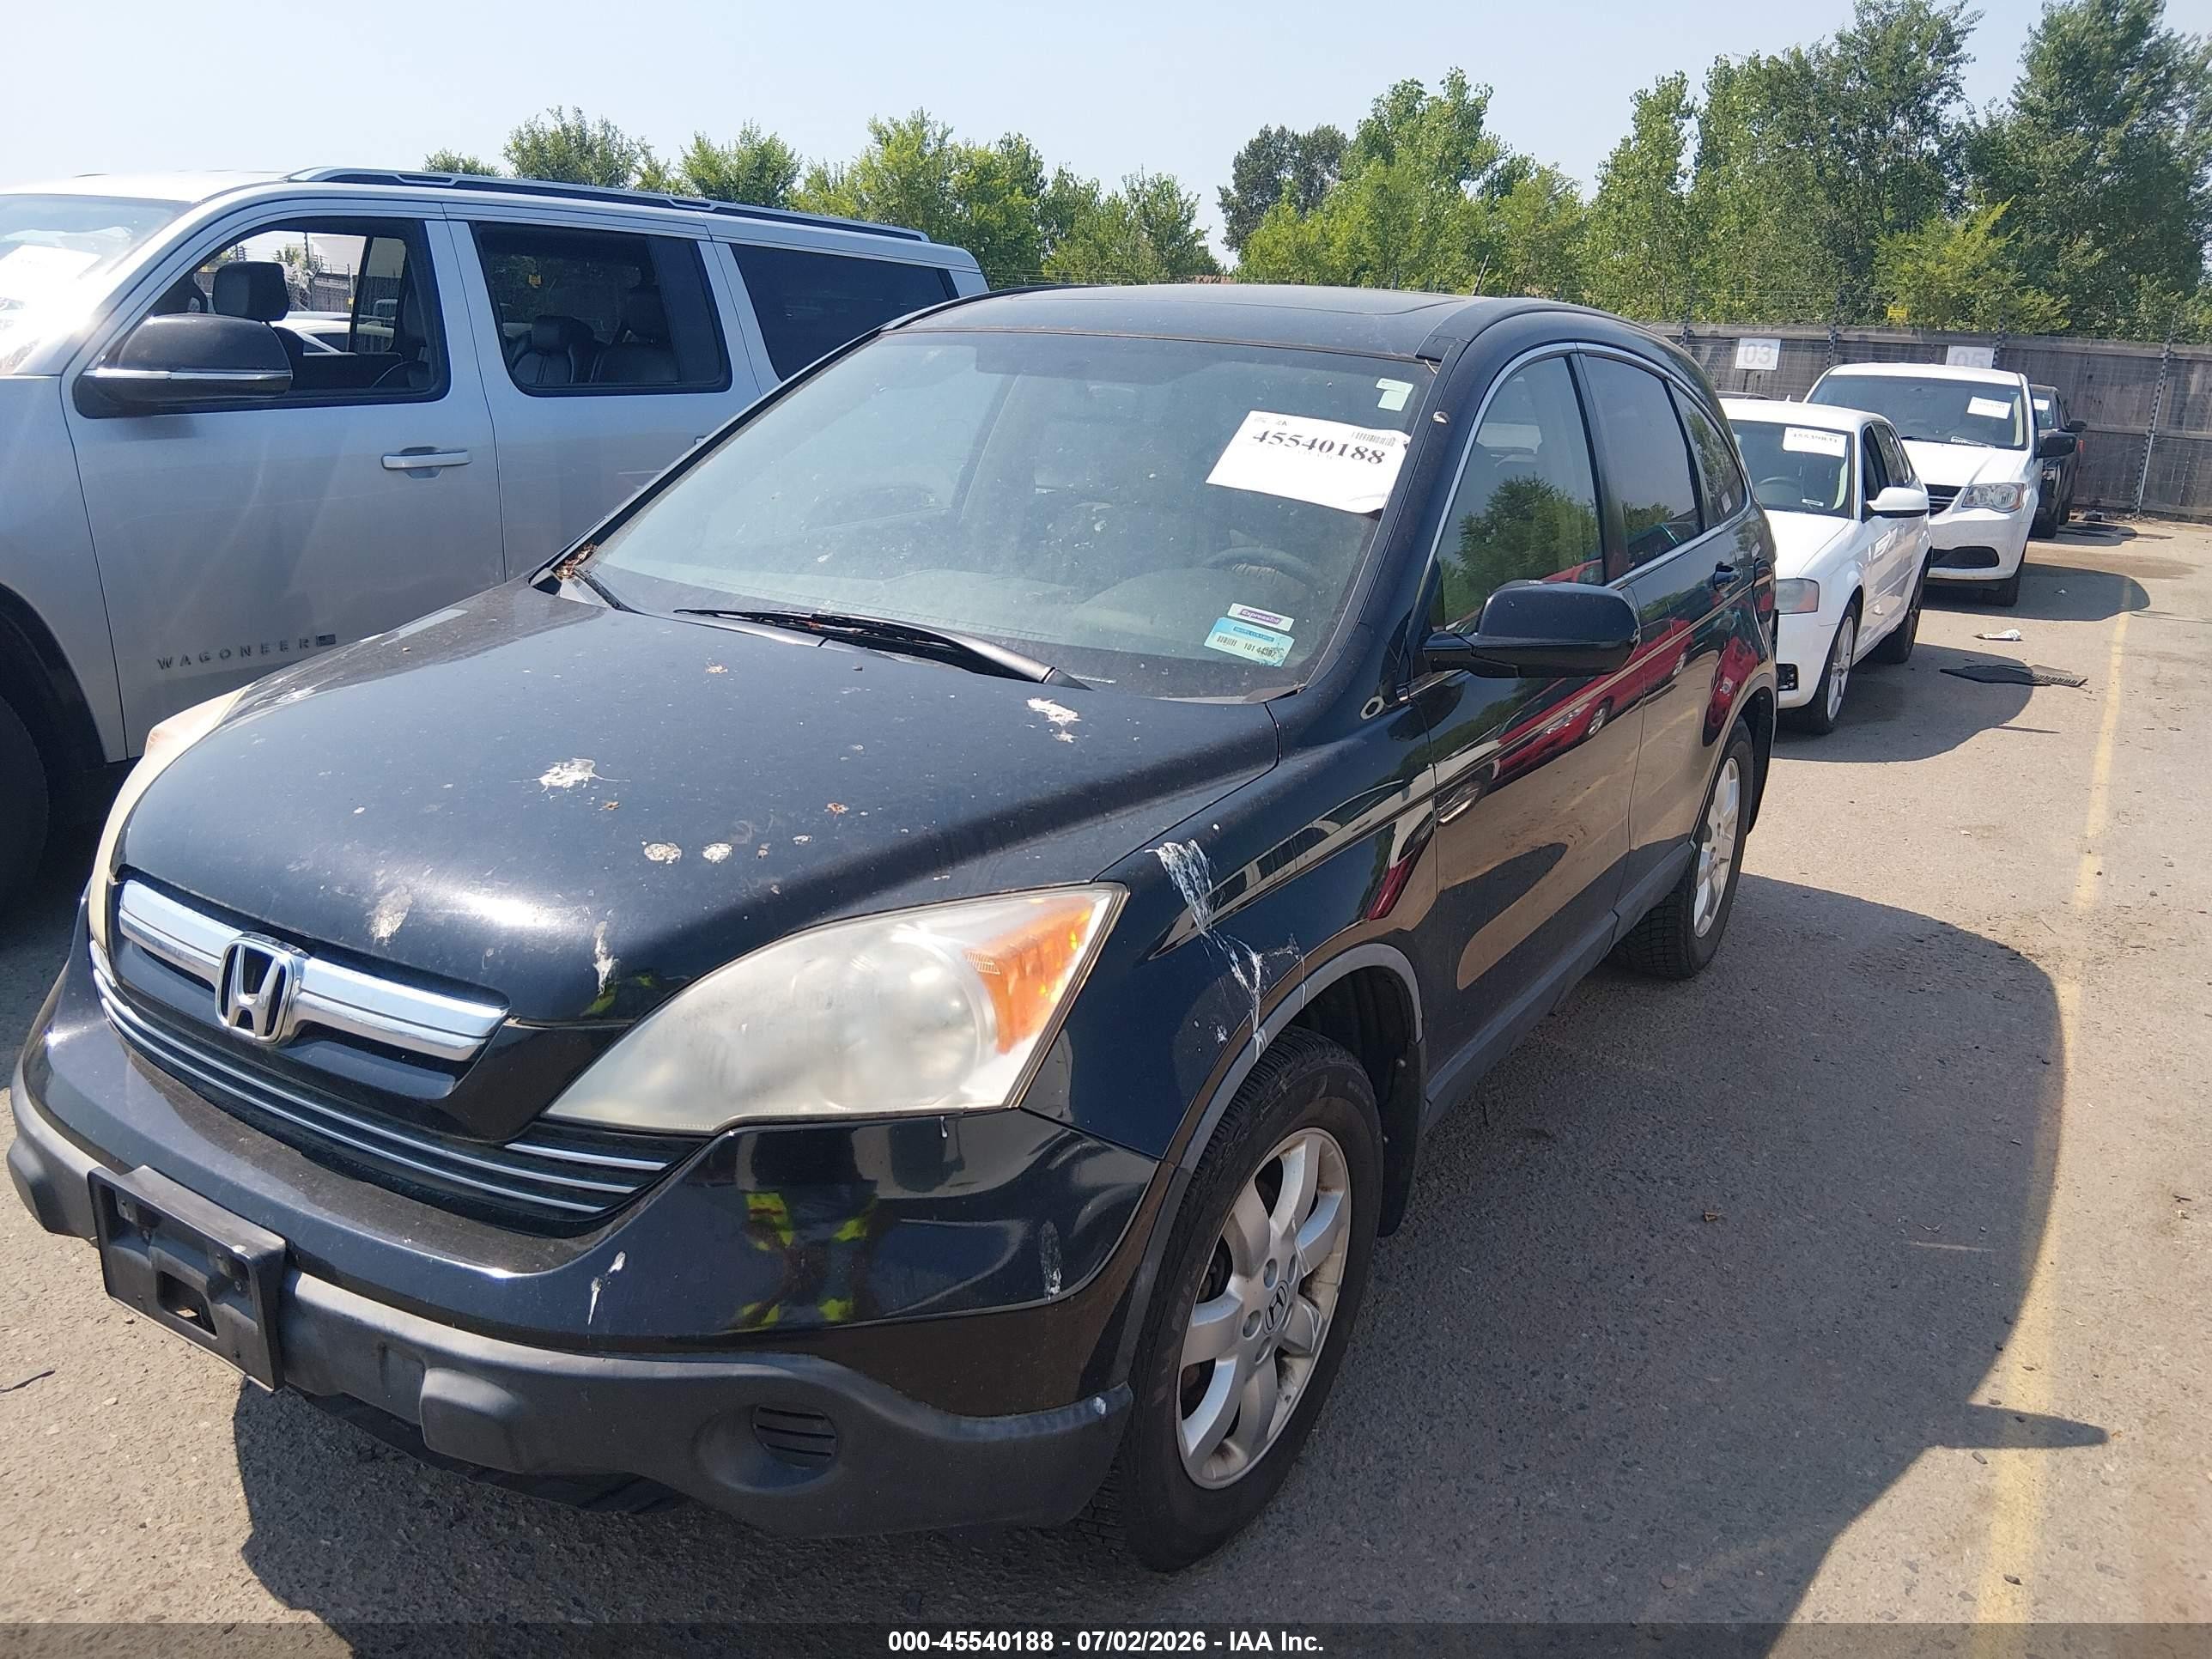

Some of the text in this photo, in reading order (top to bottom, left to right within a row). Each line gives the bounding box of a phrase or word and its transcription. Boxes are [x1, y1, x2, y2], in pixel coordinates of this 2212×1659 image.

[1744, 343, 1771, 365] 03
[1252, 429, 1386, 465] 45540188
[156, 638, 309, 670] WAGONEER
